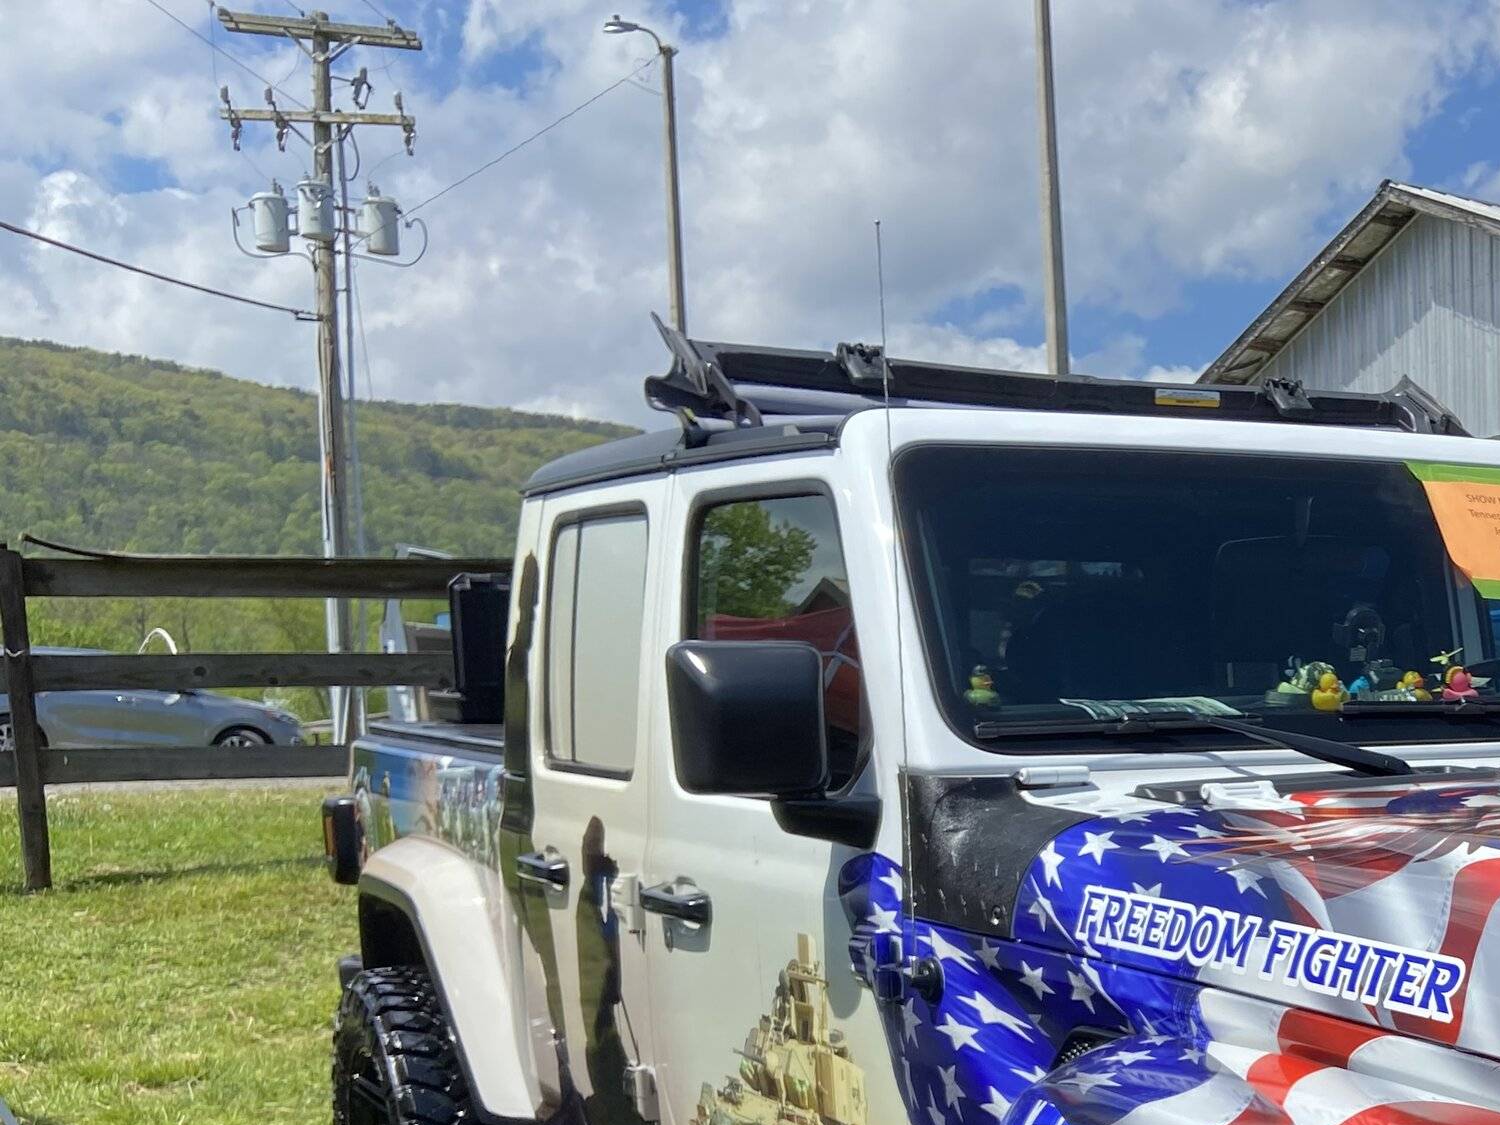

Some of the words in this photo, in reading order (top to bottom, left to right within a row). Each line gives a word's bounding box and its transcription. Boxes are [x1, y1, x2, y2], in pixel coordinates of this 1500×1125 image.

[1465, 494, 1496, 504] SHOW
[1078, 886, 1261, 973] FREEDOM
[1259, 920, 1466, 1022] FIGHTER
